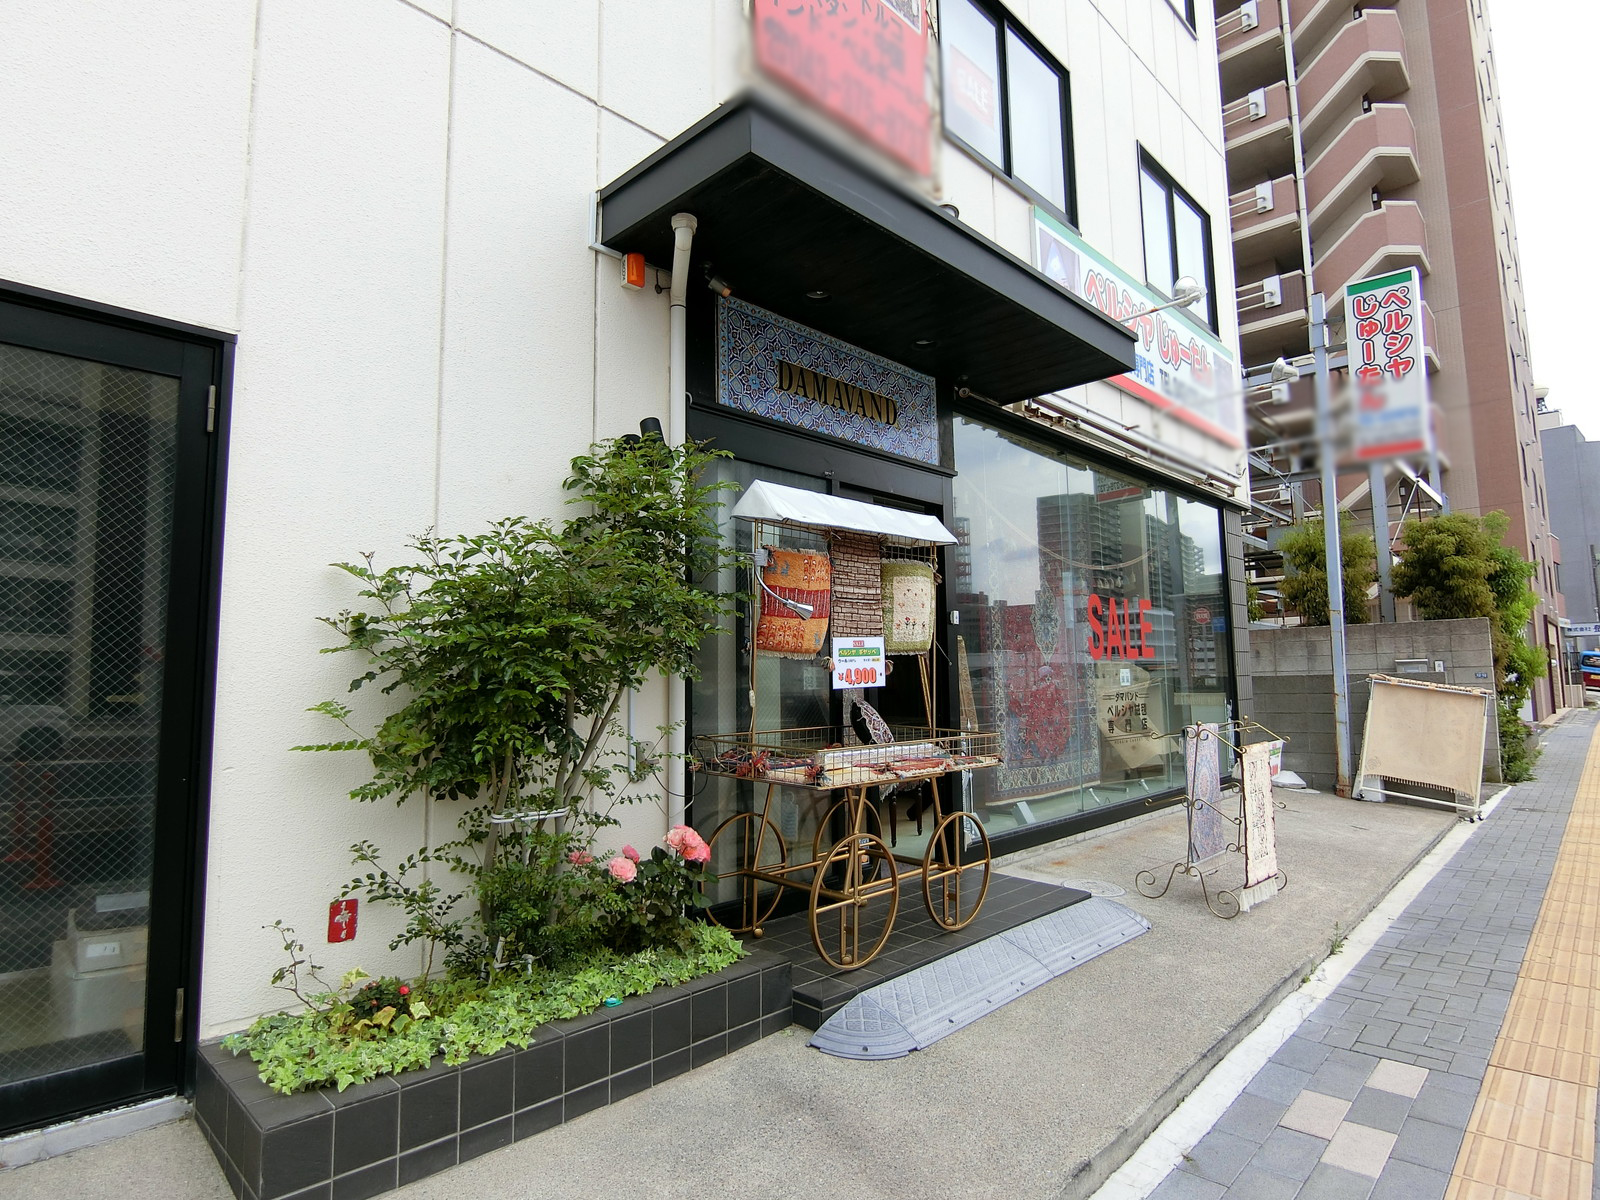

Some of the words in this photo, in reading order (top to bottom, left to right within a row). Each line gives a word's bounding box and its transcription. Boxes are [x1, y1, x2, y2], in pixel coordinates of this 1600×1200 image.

[778, 360, 898, 425] DAMAVAND
[1087, 593, 1155, 660] SALE
[1115, 691, 1139, 702] ダマバンド
